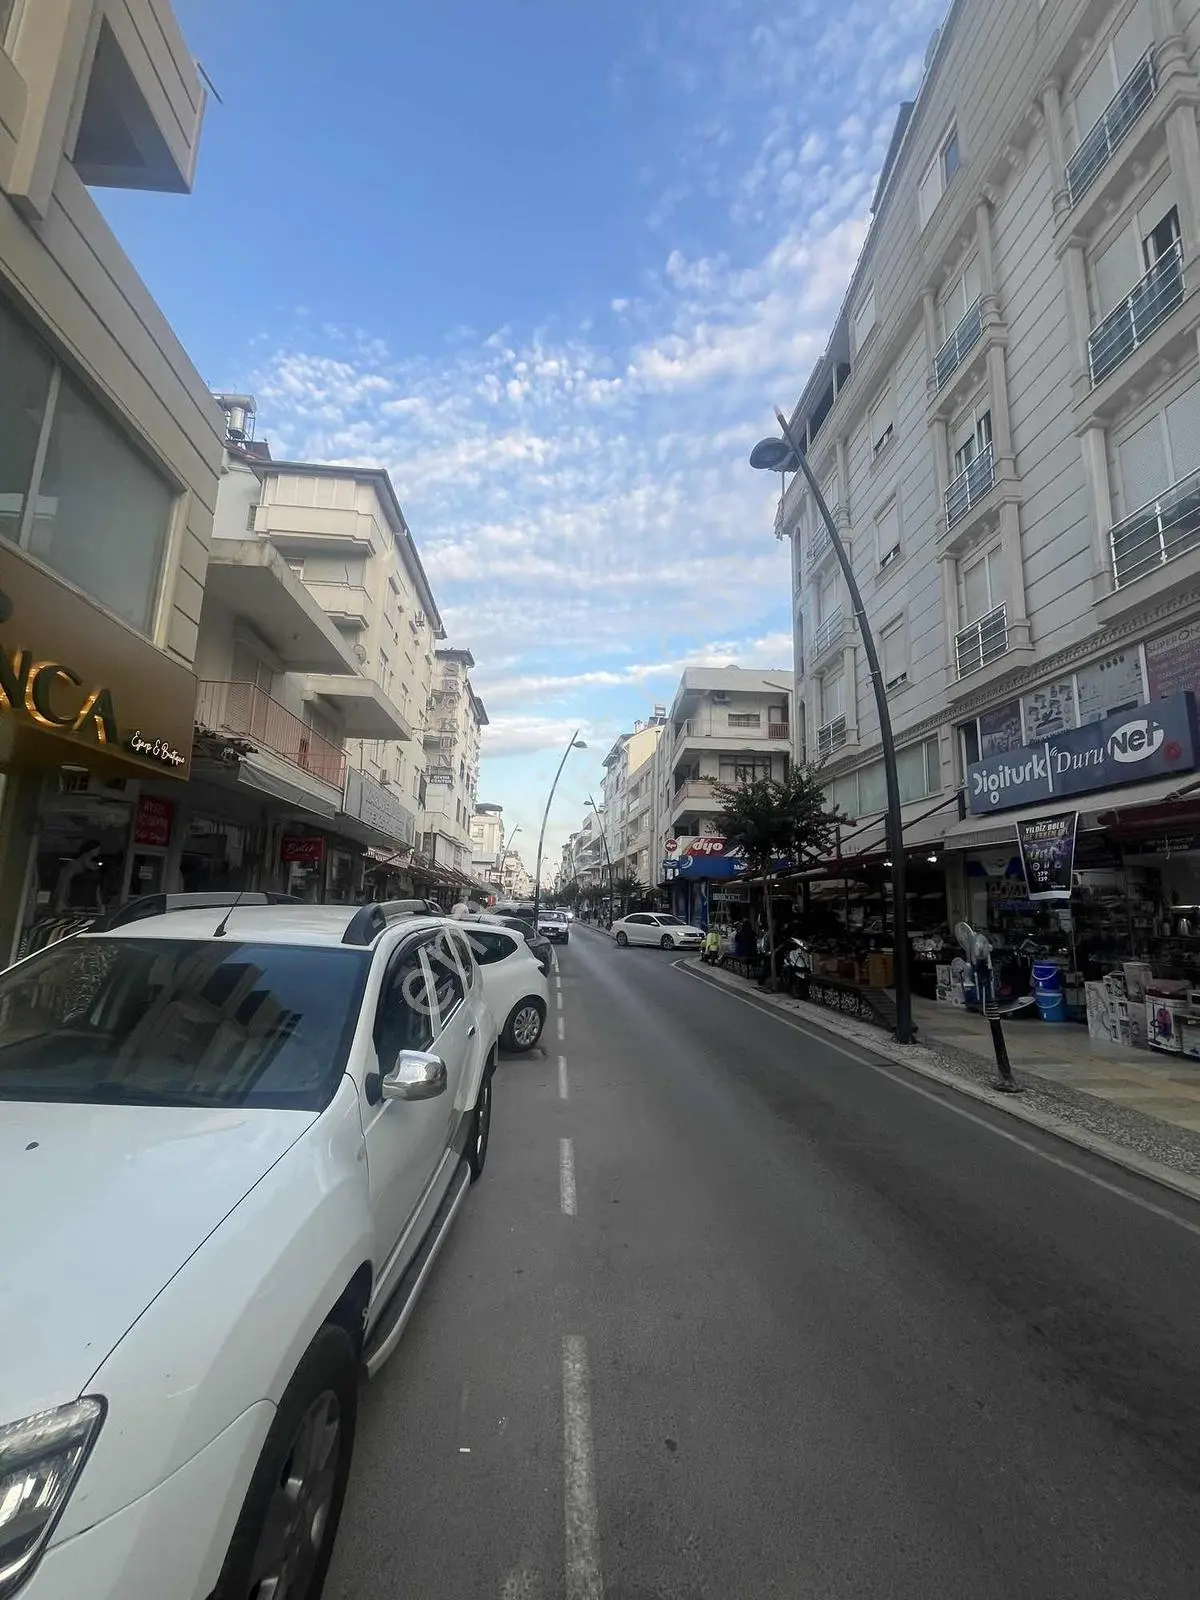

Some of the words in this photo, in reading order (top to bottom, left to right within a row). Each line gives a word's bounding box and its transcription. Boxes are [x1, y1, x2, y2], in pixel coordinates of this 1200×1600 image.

[973, 753, 1047, 805] Digiturk
[1055, 744, 1105, 773] Duru
[1110, 719, 1163, 754] Net
[692, 838, 723, 854] dyo
